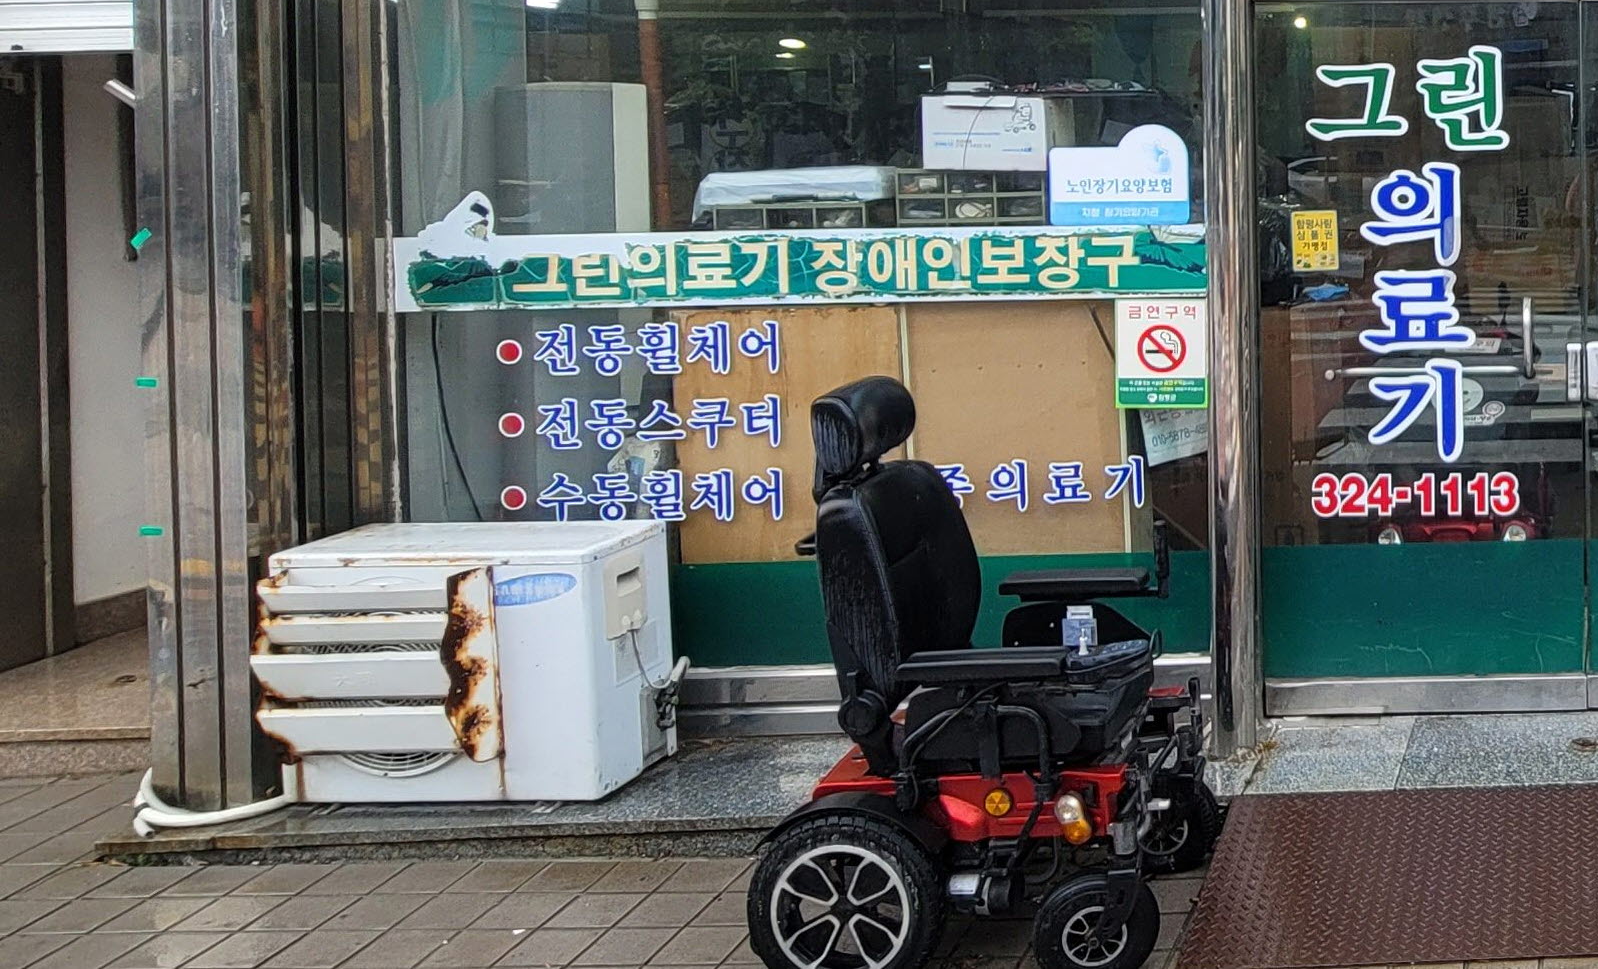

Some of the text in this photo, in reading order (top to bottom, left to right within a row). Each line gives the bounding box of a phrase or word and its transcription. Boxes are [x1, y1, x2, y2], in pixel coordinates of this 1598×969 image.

[1306, 45, 1510, 151] 그린
[1066, 177, 1173, 195] 노인장기요양보험
[810, 236, 1140, 293] 장애인보장구
[1128, 305, 1198, 320] 금연구역
[534, 320, 780, 376] 전동휠체어
[536, 394, 782, 449] 전동스쿠터
[537, 468, 784, 521] 수동휠체어
[1312, 471, 1520, 517] 324-1113
